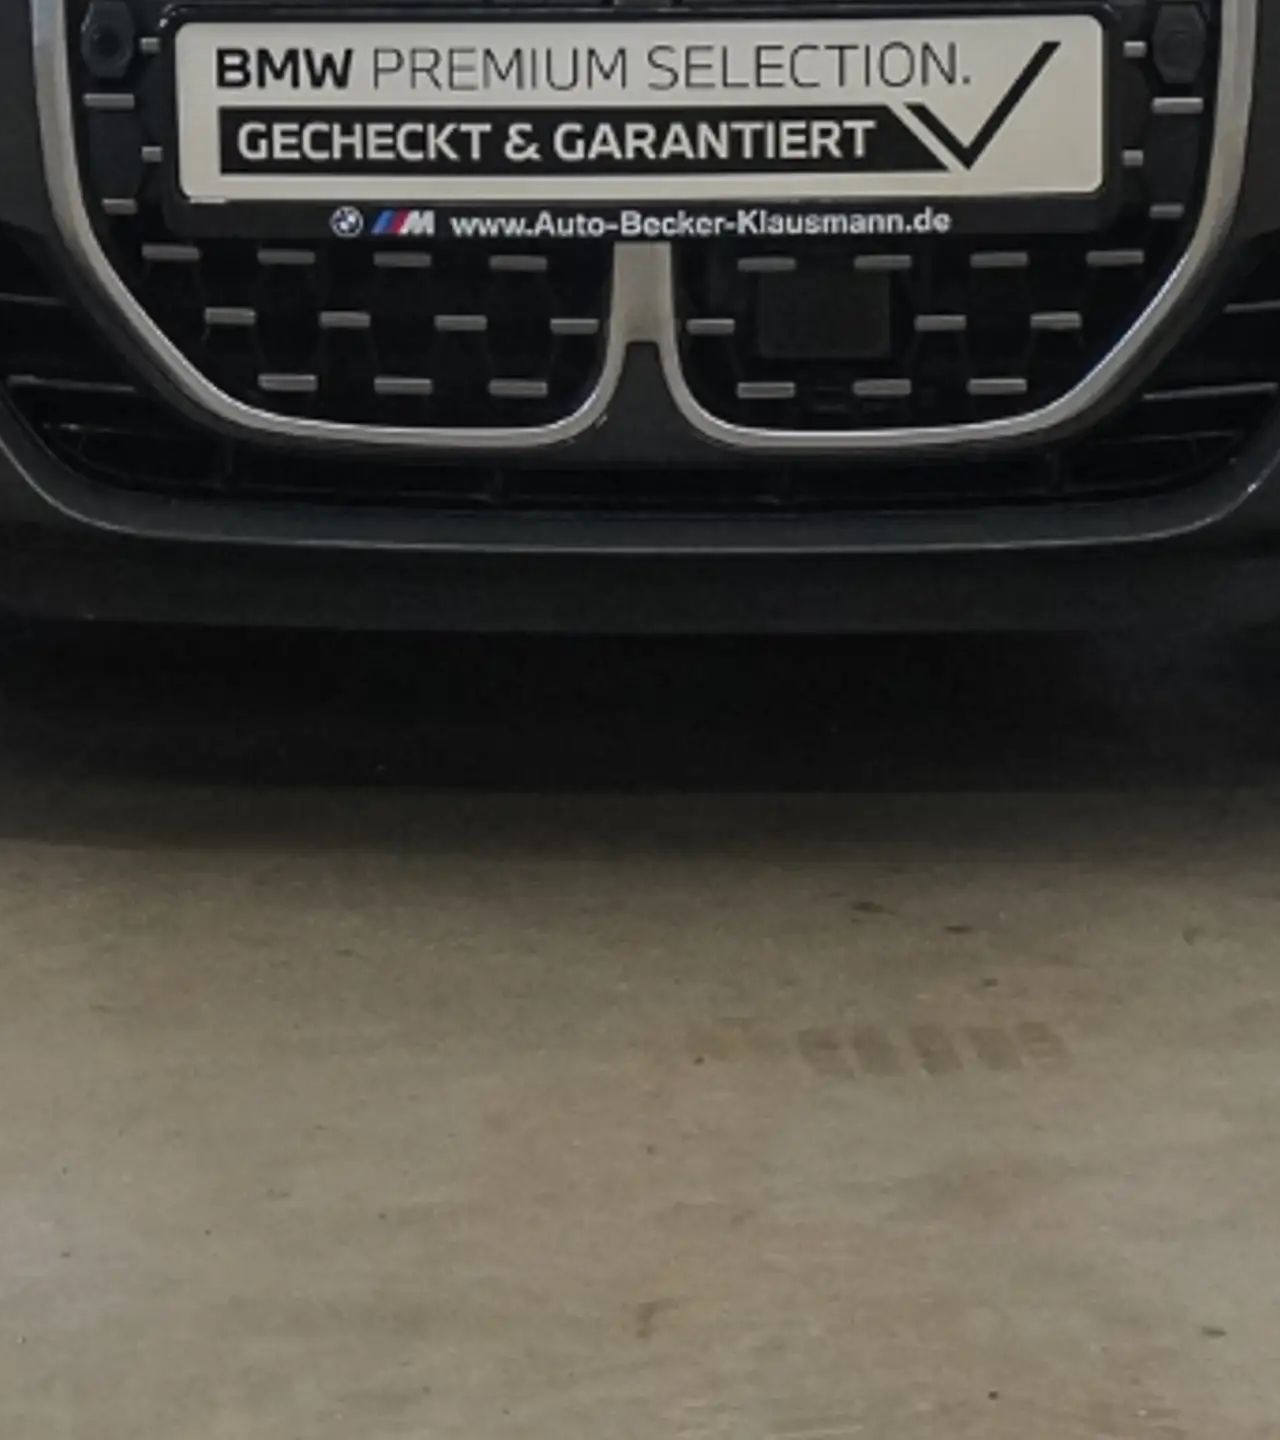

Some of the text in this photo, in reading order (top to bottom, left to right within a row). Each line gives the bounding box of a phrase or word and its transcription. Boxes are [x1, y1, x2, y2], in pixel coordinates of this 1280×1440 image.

[216, 41, 972, 91] BMW PREMIUM SELECTION.
[237, 119, 877, 161] GECHECKT & GARANTIERT
[449, 207, 952, 238] www.Auto-Becker-Klausmann.de
